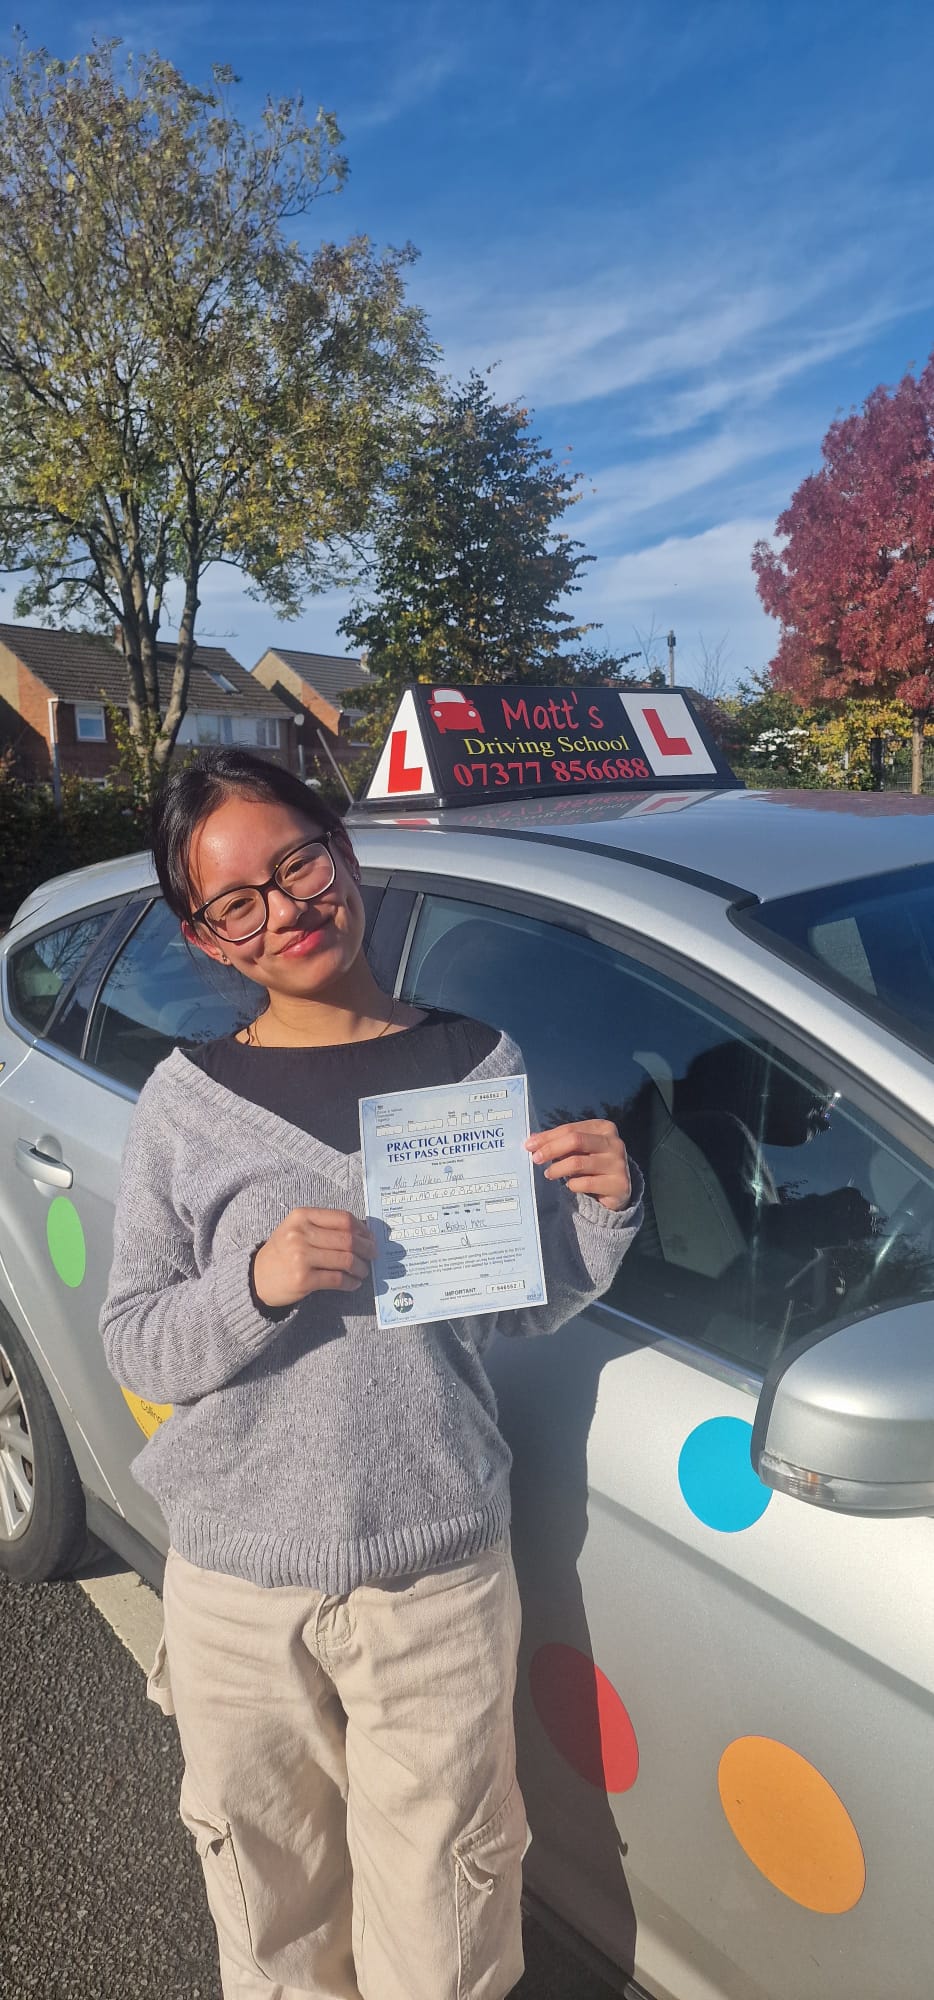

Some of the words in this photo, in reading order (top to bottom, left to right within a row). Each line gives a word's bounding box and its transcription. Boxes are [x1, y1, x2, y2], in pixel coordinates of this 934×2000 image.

[500, 691, 604, 731] Matt's
[463, 737, 556, 758] Driving
[560, 735, 631, 753] School
[641, 709, 693, 756] L
[387, 730, 423, 793] L
[453, 761, 542, 787] 07377
[552, 758, 650, 782] 856688
[387, 1135, 449, 1153] PRACTICAL
[453, 1128, 505, 1144] DRIVING
[387, 1151, 411, 1163] TEST
[415, 1149, 439, 1160] PASS
[442, 1139, 505, 1156] CERTIFICATE
